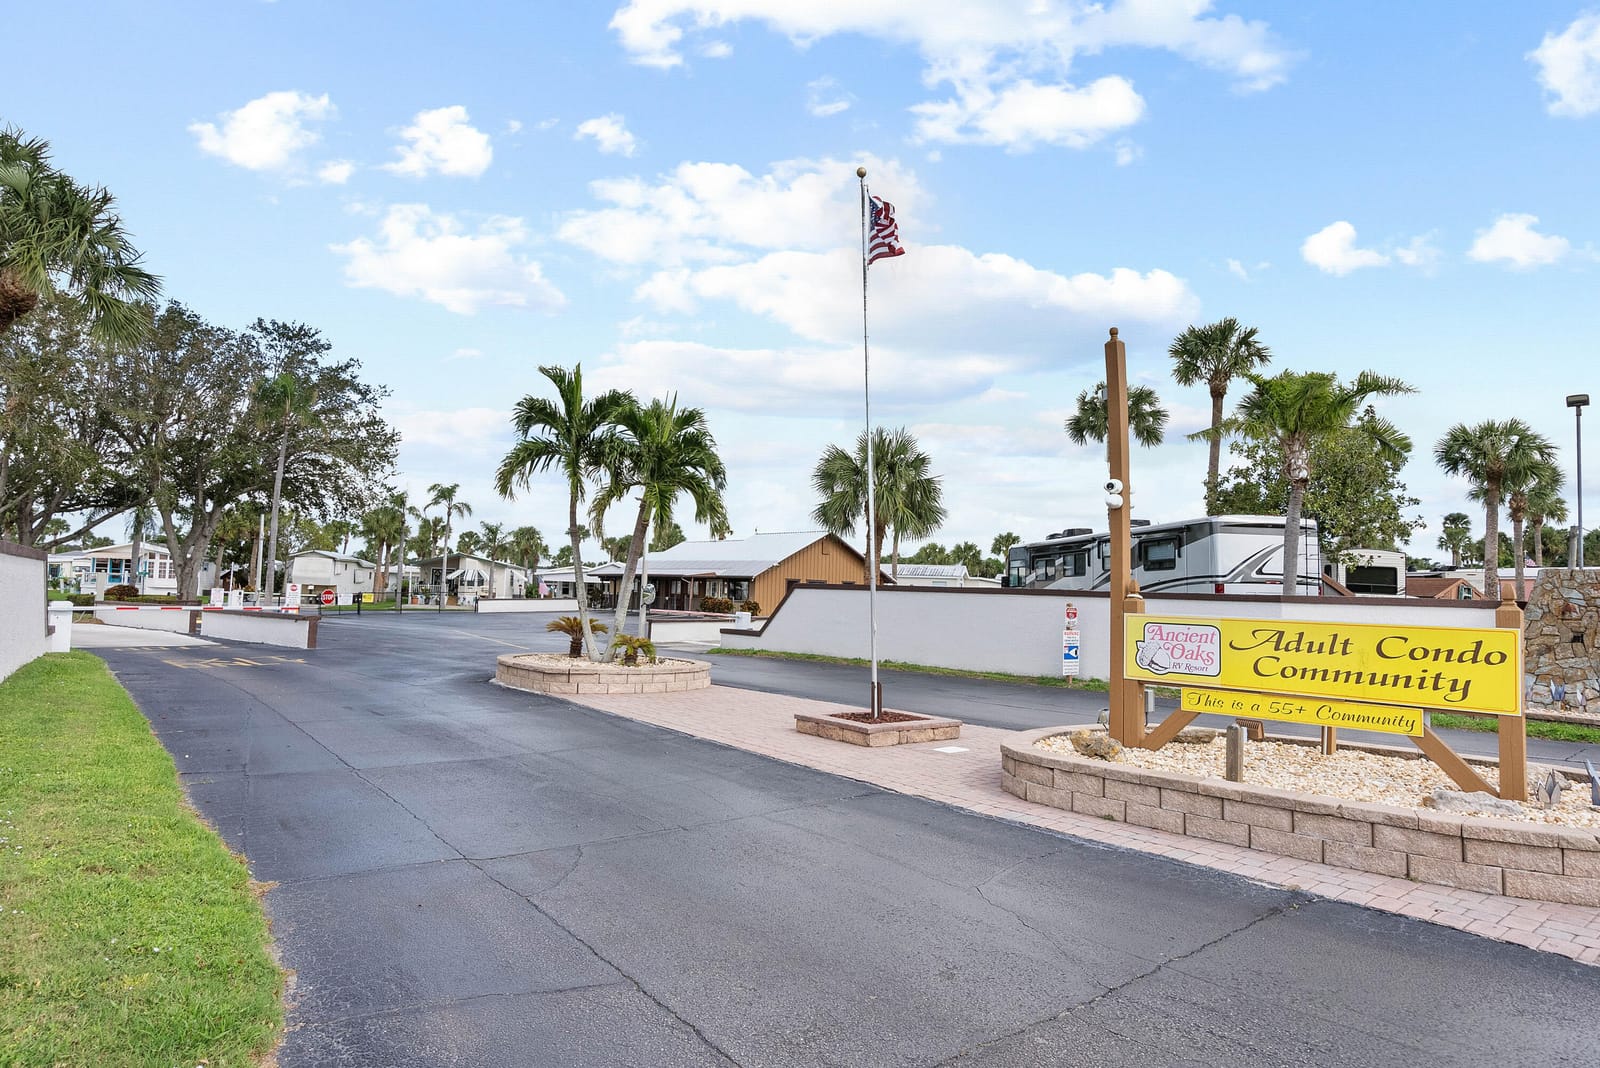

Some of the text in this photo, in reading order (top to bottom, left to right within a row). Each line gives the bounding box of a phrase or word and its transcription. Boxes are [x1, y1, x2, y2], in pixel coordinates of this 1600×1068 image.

[1147, 624, 1216, 645] Ancient
[1229, 628, 1508, 666] Adult Condo
[1163, 642, 1215, 667] Oaks
[1171, 662, 1209, 674] RV Resort
[1253, 655, 1472, 703] Community
[1187, 692, 1416, 733] This is a 55+ Community
